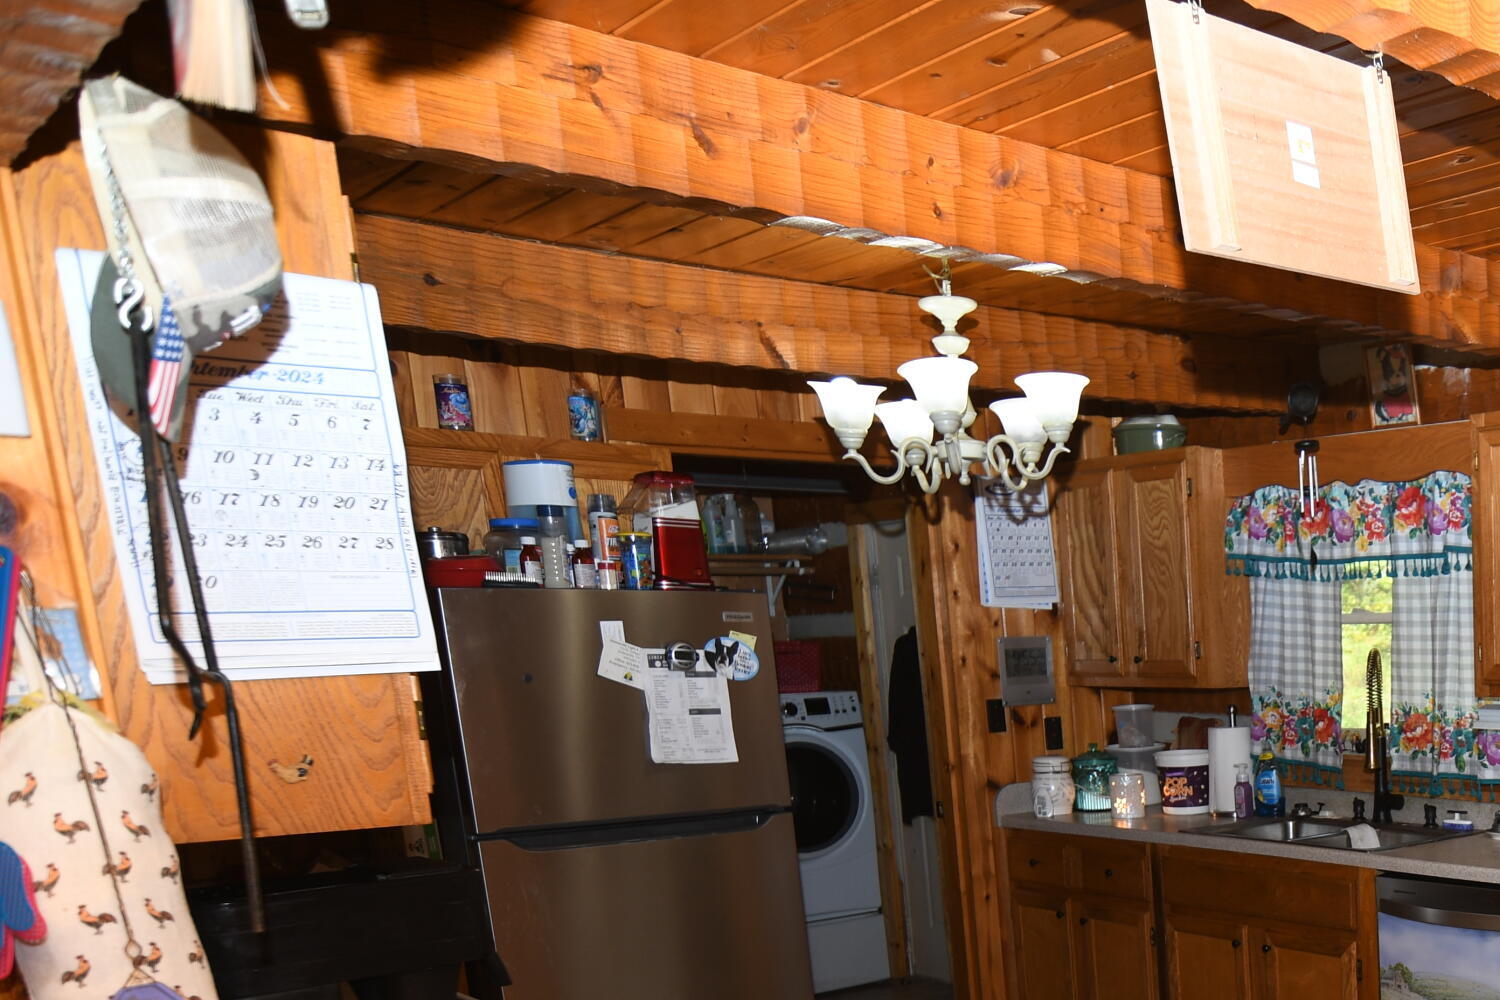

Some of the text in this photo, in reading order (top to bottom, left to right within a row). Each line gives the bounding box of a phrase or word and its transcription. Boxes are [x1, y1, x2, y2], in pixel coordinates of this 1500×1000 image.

[276, 368, 326, 386] 2024
[235, 391, 265, 405] Wed
[274, 393, 304, 408] Thu
[314, 397, 340, 411] Fri
[351, 400, 376, 412] Sat
[208, 407, 372, 431] 3 4 5 6 7
[213, 450, 236, 466] 10
[253, 452, 275, 468] 11
[291, 454, 315, 469] 12
[327, 456, 350, 471] 13
[365, 458, 386, 473] 14
[219, 492, 242, 507] 17
[259, 494, 282, 509] 18
[298, 496, 320, 510] 19
[334, 496, 356, 511] 20
[369, 498, 389, 512] 21
[225, 535, 250, 549] 24
[264, 535, 288, 550] 25
[301, 536, 323, 551] 26
[338, 537, 361, 551] 27
[374, 537, 395, 551] 28
[1163, 785, 1193, 797] CORN
[1165, 777, 1188, 790] POP
